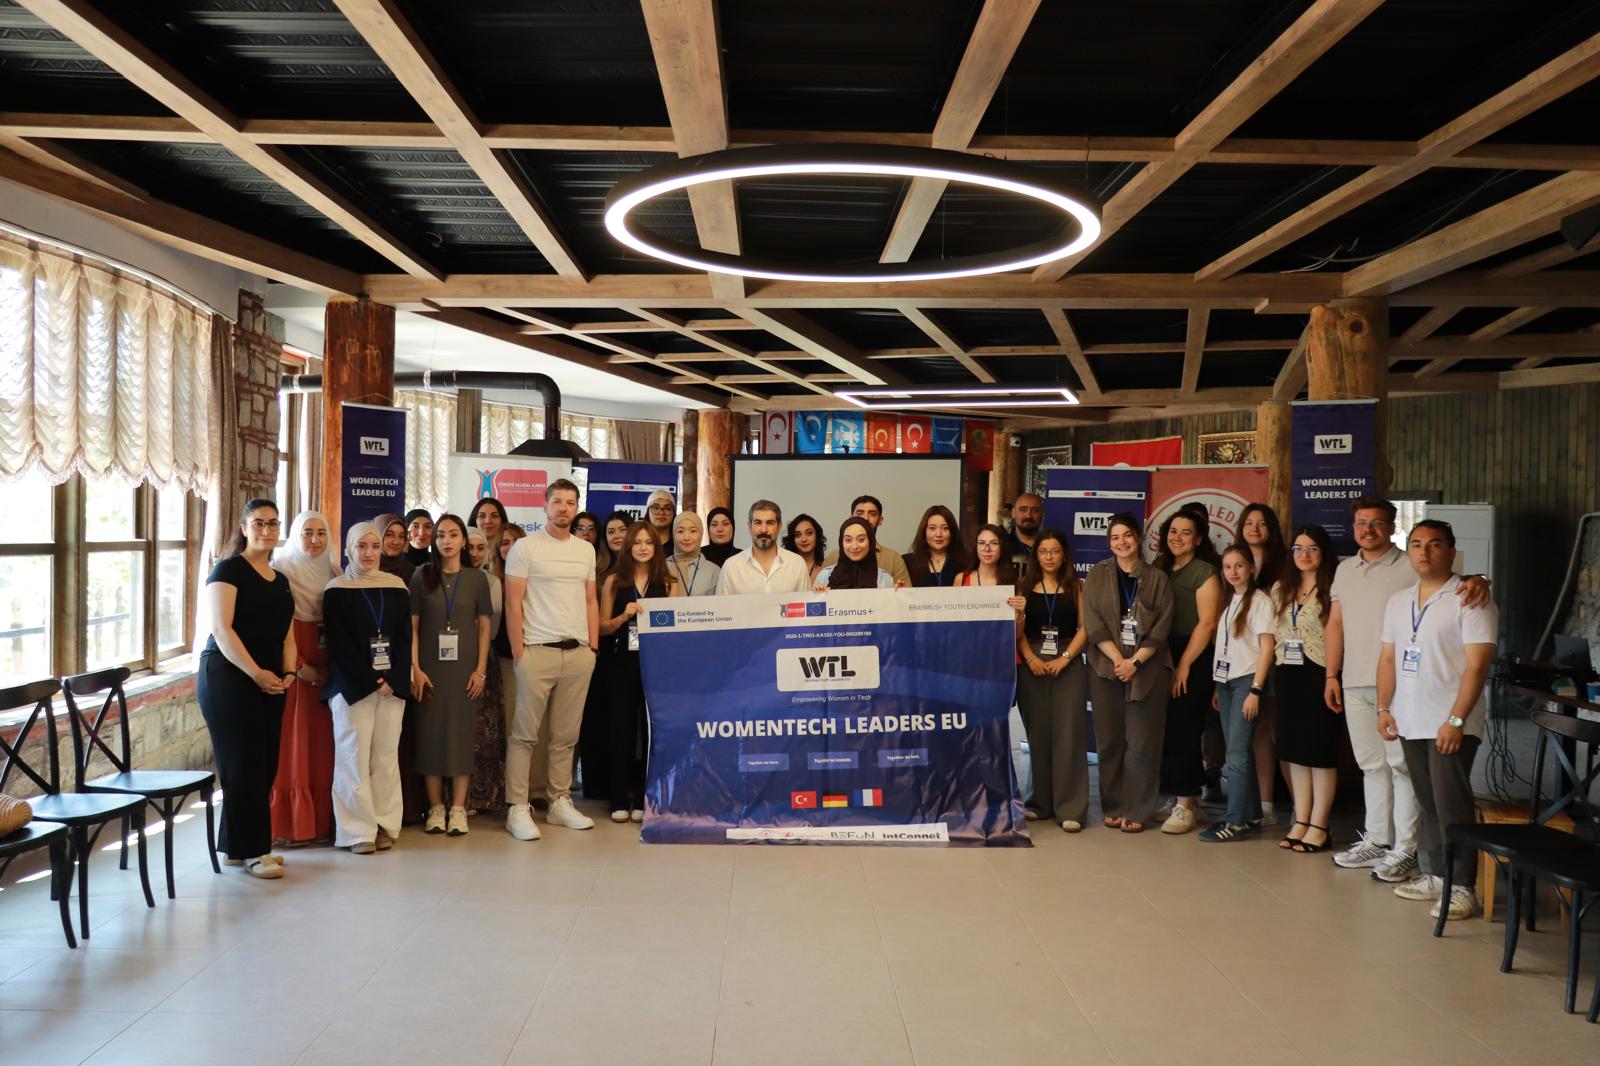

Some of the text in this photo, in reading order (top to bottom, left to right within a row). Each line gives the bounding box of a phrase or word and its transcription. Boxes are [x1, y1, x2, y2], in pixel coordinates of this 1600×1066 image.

[364, 440, 385, 451] WTL
[1319, 438, 1347, 449] WTL
[349, 477, 399, 486] WOMENTECH
[1301, 478, 1366, 487] WOMENTECH
[352, 488, 396, 498] LEADERS EU
[1304, 490, 1361, 499] LEADERS EU
[1080, 517, 1107, 529] WTL
[966, 602, 1001, 610] EXCHANGE
[828, 607, 874, 616] Erasmus+
[798, 655, 856, 678] WTL
[791, 696, 827, 704] Empowering
[857, 694, 872, 702] Tech
[696, 712, 967, 738] WOMENTECH LEADERS EU
